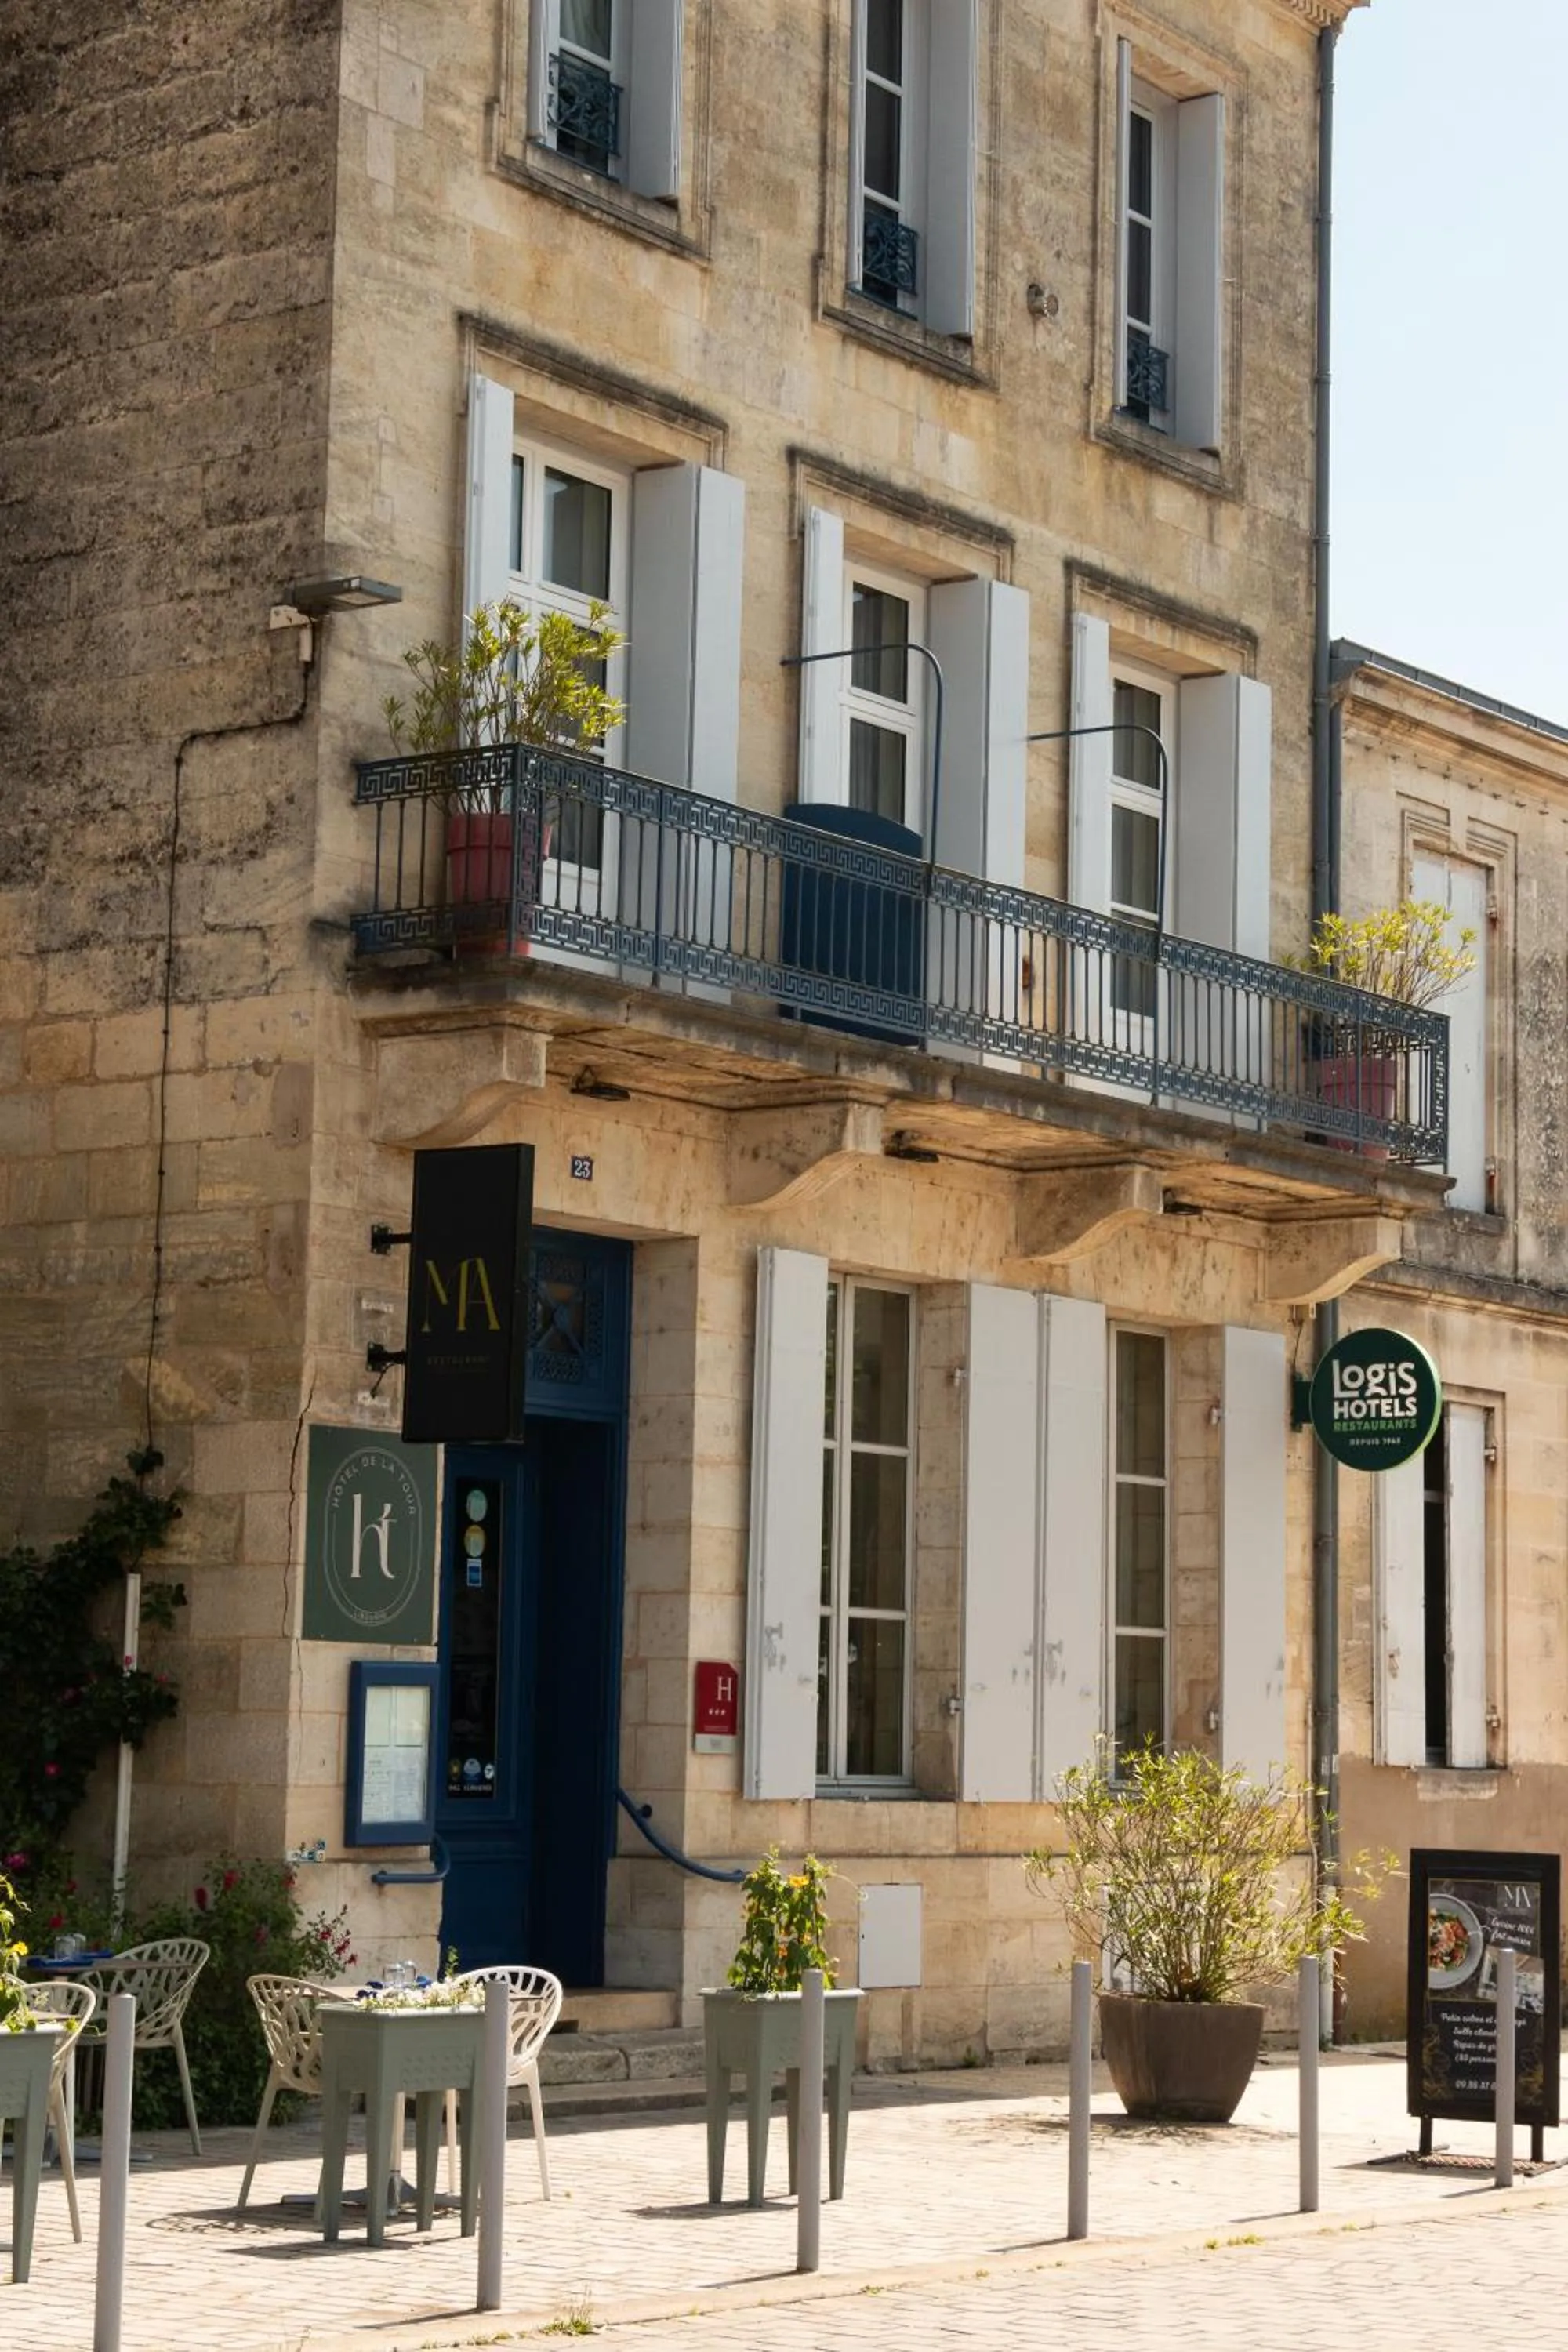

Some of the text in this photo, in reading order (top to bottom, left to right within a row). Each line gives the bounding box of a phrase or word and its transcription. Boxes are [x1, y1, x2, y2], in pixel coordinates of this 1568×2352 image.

[574, 1160, 590, 1178] 23
[421, 1257, 501, 1333] MA
[1334, 1396, 1417, 1420] HOTELS
[1333, 1418, 1417, 1432] RESTAURANTS
[1349, 1438, 1380, 1446] DEPUIS
[361, 1455, 377, 1467] DE
[381, 1457, 395, 1475] LA
[397, 1473, 416, 1515] TOUR
[717, 1675, 732, 1702] H
